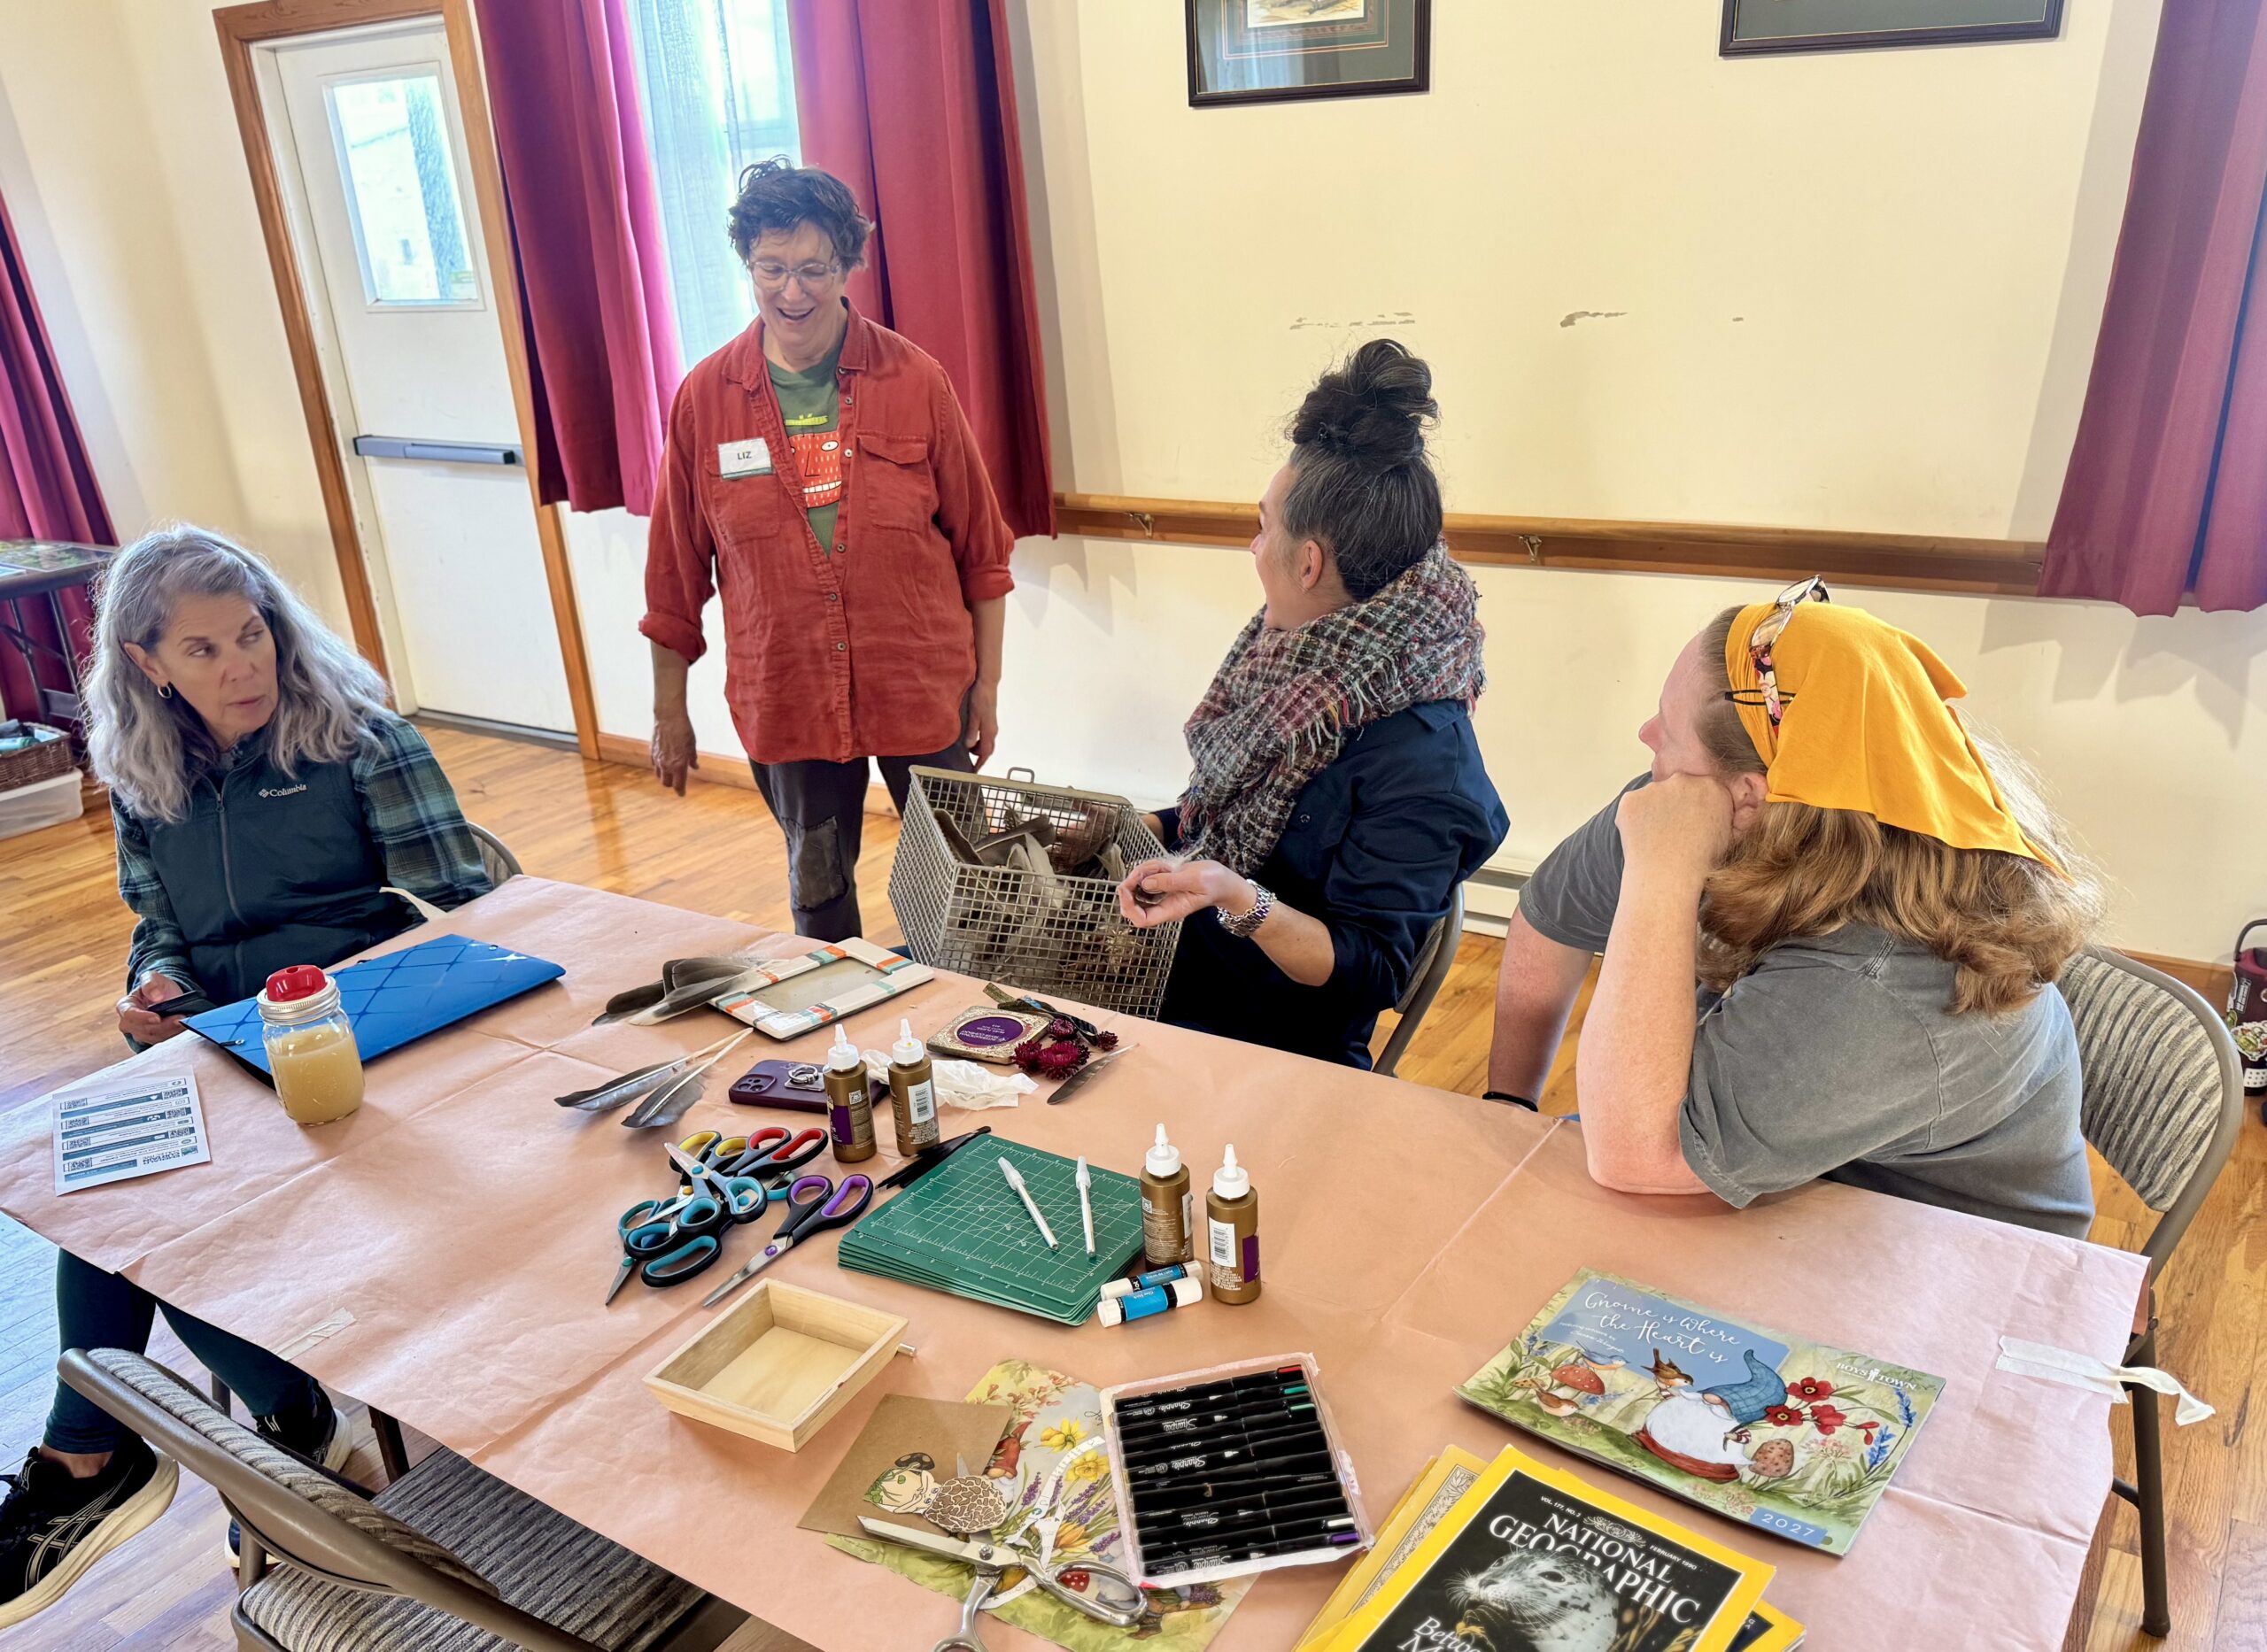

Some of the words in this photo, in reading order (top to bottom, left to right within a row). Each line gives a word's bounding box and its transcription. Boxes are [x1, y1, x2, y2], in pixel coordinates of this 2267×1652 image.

[737, 451, 753, 460] LIZ
[269, 784, 307, 797] Columbia
[1585, 1291, 1658, 1317] Gnome
[1662, 1313, 1679, 1324] is
[1680, 1316, 1740, 1346] Where
[1592, 1314, 1631, 1331] the
[1634, 1319, 1706, 1355] Heart
[1709, 1350, 1729, 1363] is
[1836, 1363, 1869, 1377] BOYS
[1876, 1374, 1917, 1390] TOWN
[1171, 1455, 1207, 1470] Sharpie
[1541, 1495, 1552, 1505] VOL.
[1565, 1507, 1576, 1516] NO.
[1762, 1512, 1816, 1537] 2027
[1543, 1512, 1673, 1584] NATIONAL
[1649, 1545, 1682, 1563] FEBRUARY
[1682, 1560, 1698, 1571] 1990
